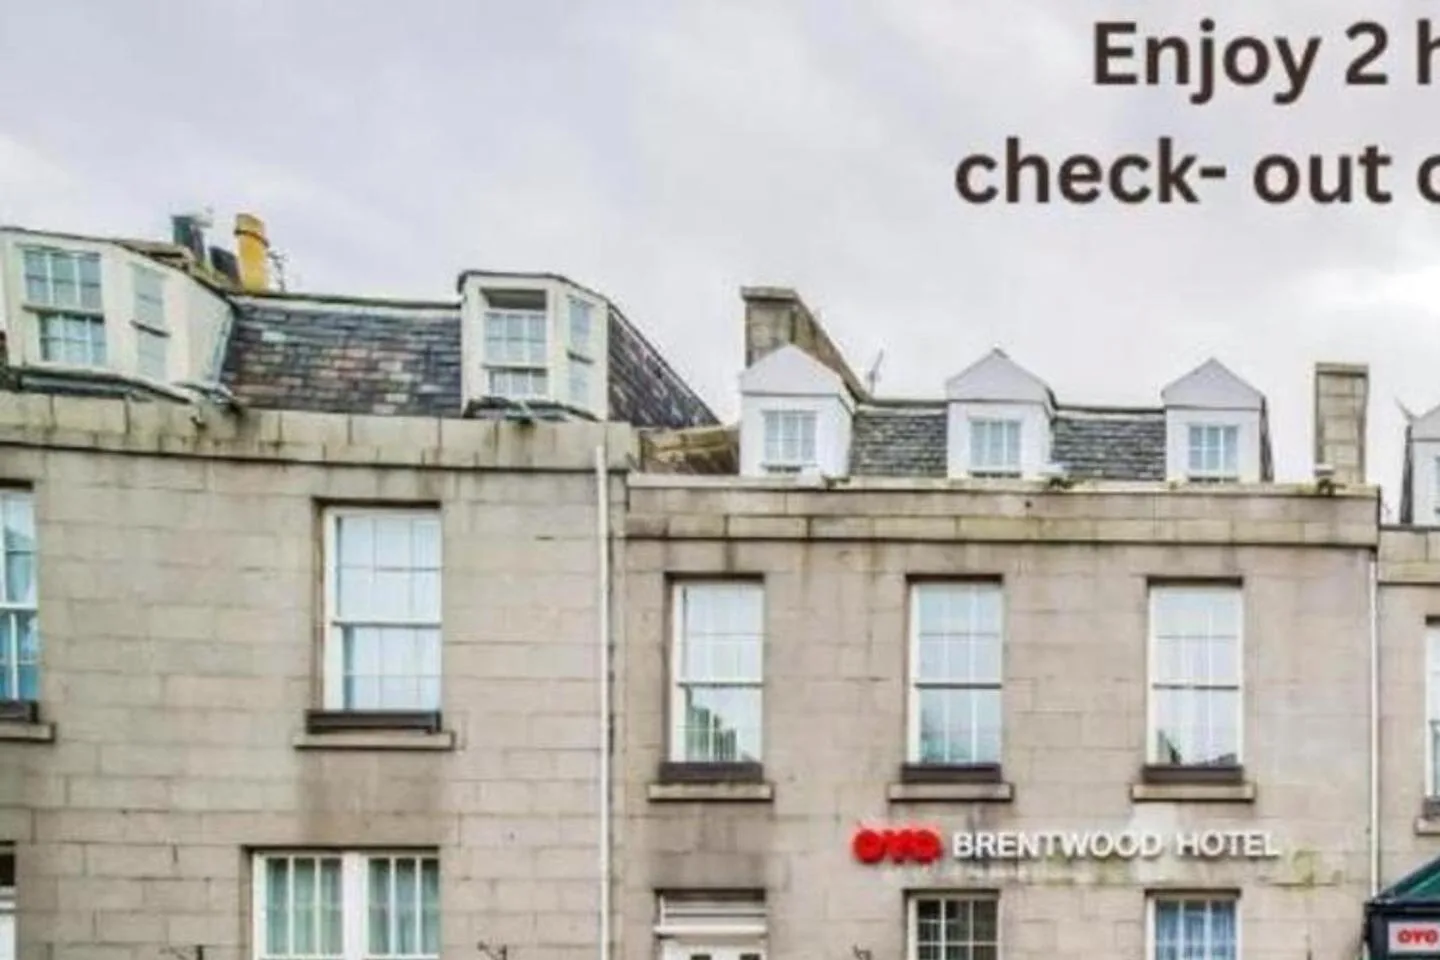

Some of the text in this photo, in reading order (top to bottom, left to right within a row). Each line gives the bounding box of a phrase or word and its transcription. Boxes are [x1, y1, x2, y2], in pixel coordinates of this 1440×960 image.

[953, 830, 1165, 858] BRENTWOOD
[1174, 830, 1284, 858] HOTEL
[1397, 928, 1439, 946] OYO
